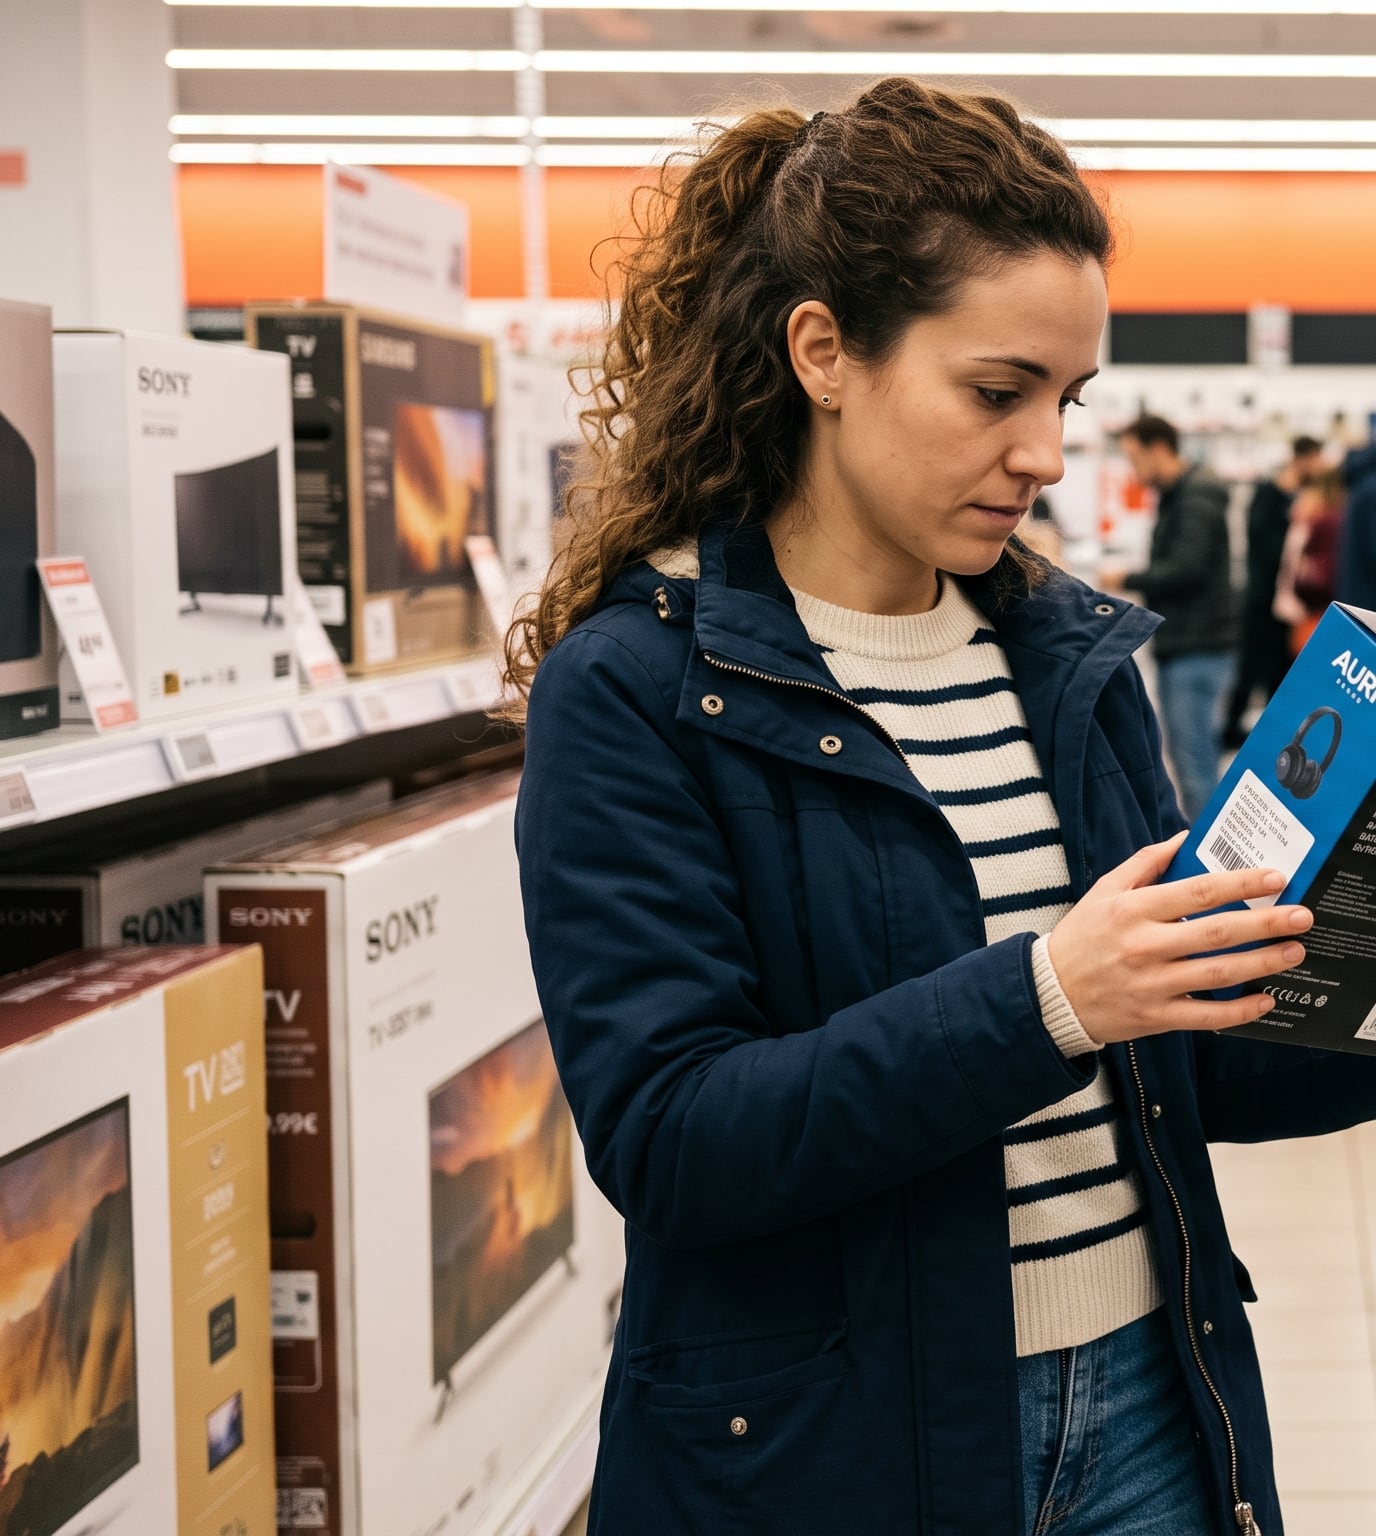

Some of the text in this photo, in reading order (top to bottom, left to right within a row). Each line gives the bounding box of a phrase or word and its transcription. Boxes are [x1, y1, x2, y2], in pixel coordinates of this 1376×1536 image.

[138, 365, 193, 400] SONY
[0, 908, 68, 928] ONY
[229, 906, 313, 928] SONY
[365, 893, 440, 965] SONY
[182, 1053, 217, 1113] TV
